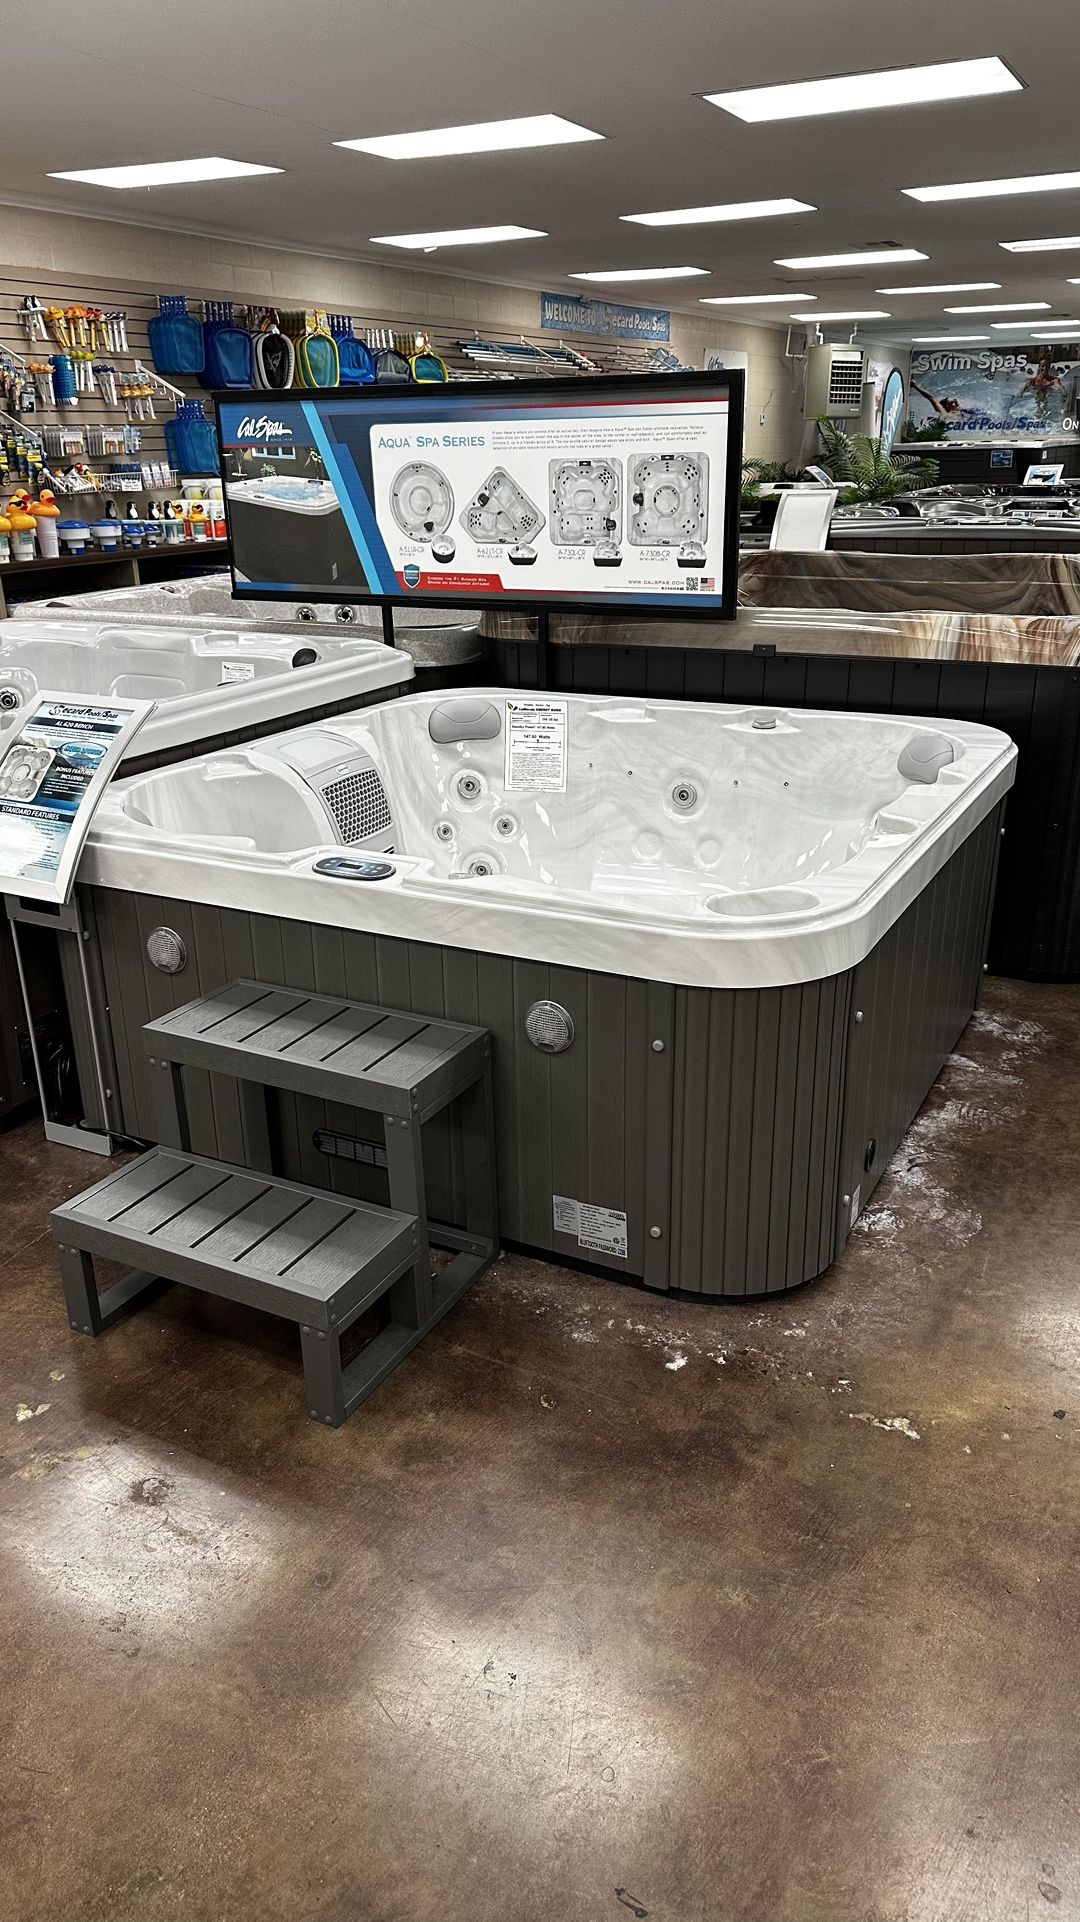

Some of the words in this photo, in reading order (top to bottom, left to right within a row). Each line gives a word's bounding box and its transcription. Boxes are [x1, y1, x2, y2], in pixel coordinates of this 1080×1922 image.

[601, 306, 634, 332] Secard
[918, 353, 972, 372] Swim
[977, 351, 1028, 372] Spas
[237, 416, 256, 438] Cal
[255, 415, 292, 441] Spas
[978, 416, 1046, 430] Pools/Spas
[416, 436, 440, 448] SPA
[442, 436, 486, 447] SERIES
[48, 704, 86, 716] Secard
[84, 708, 119, 719] Pools/Spas
[1, 806, 31, 816] STANDARD
[32, 811, 60, 820] FEATURES
